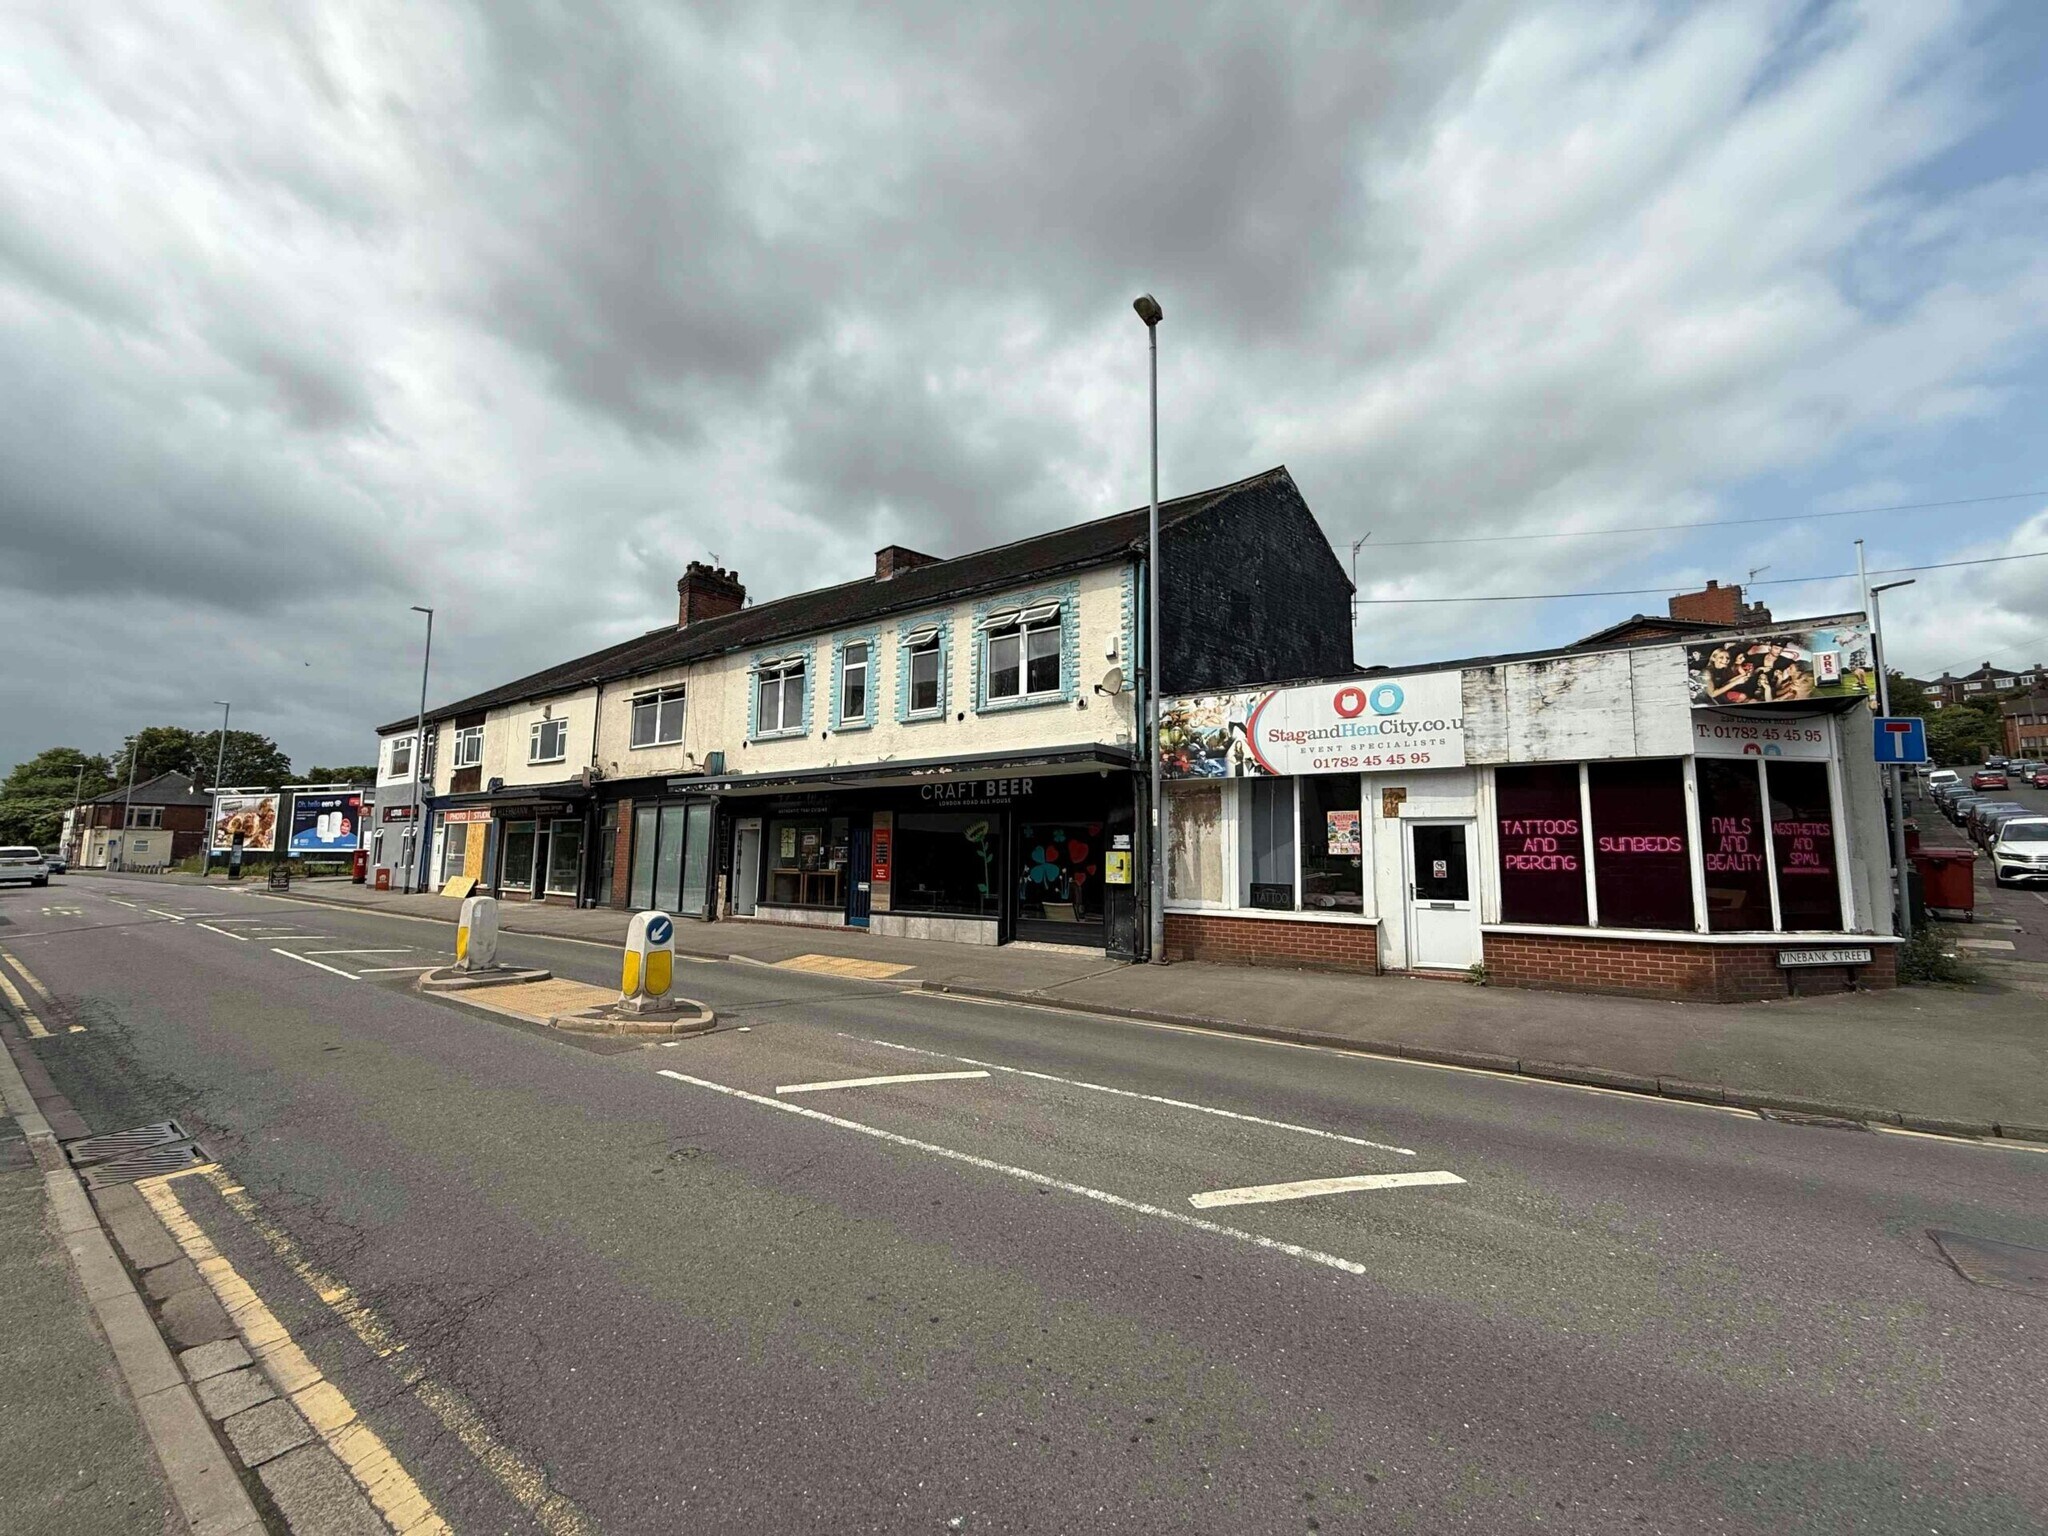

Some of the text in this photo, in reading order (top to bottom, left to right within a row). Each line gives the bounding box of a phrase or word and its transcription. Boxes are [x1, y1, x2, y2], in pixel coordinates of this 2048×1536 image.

[1823, 654, 1833, 674] DRS
[1736, 716, 1772, 725] LONDON
[1773, 717, 1797, 726] ROAD
[1696, 724, 1822, 742] T: 01782 45 45 95
[1300, 738, 1446, 754] EVENT SPECIALISTS
[1313, 752, 1431, 769] 01782 45 45 95
[921, 778, 1033, 800] CRAFT BEER
[449, 812, 467, 821] PHOTO
[1500, 820, 1578, 835] TATTOOS
[1711, 817, 1752, 834] NAILS
[1772, 823, 1831, 836] AESTHETICS
[1523, 837, 1557, 852] AND
[1599, 837, 1682, 852] SUNBEDS
[1720, 836, 1749, 853] AND
[1793, 838, 1814, 850] AND
[1505, 855, 1577, 870] PIERCING
[1706, 853, 1762, 871] BEAUTY
[1789, 853, 1820, 865] SPMU
[1253, 892, 1288, 904] TATTOO
[1779, 950, 1868, 963] VINEBANK STREET
